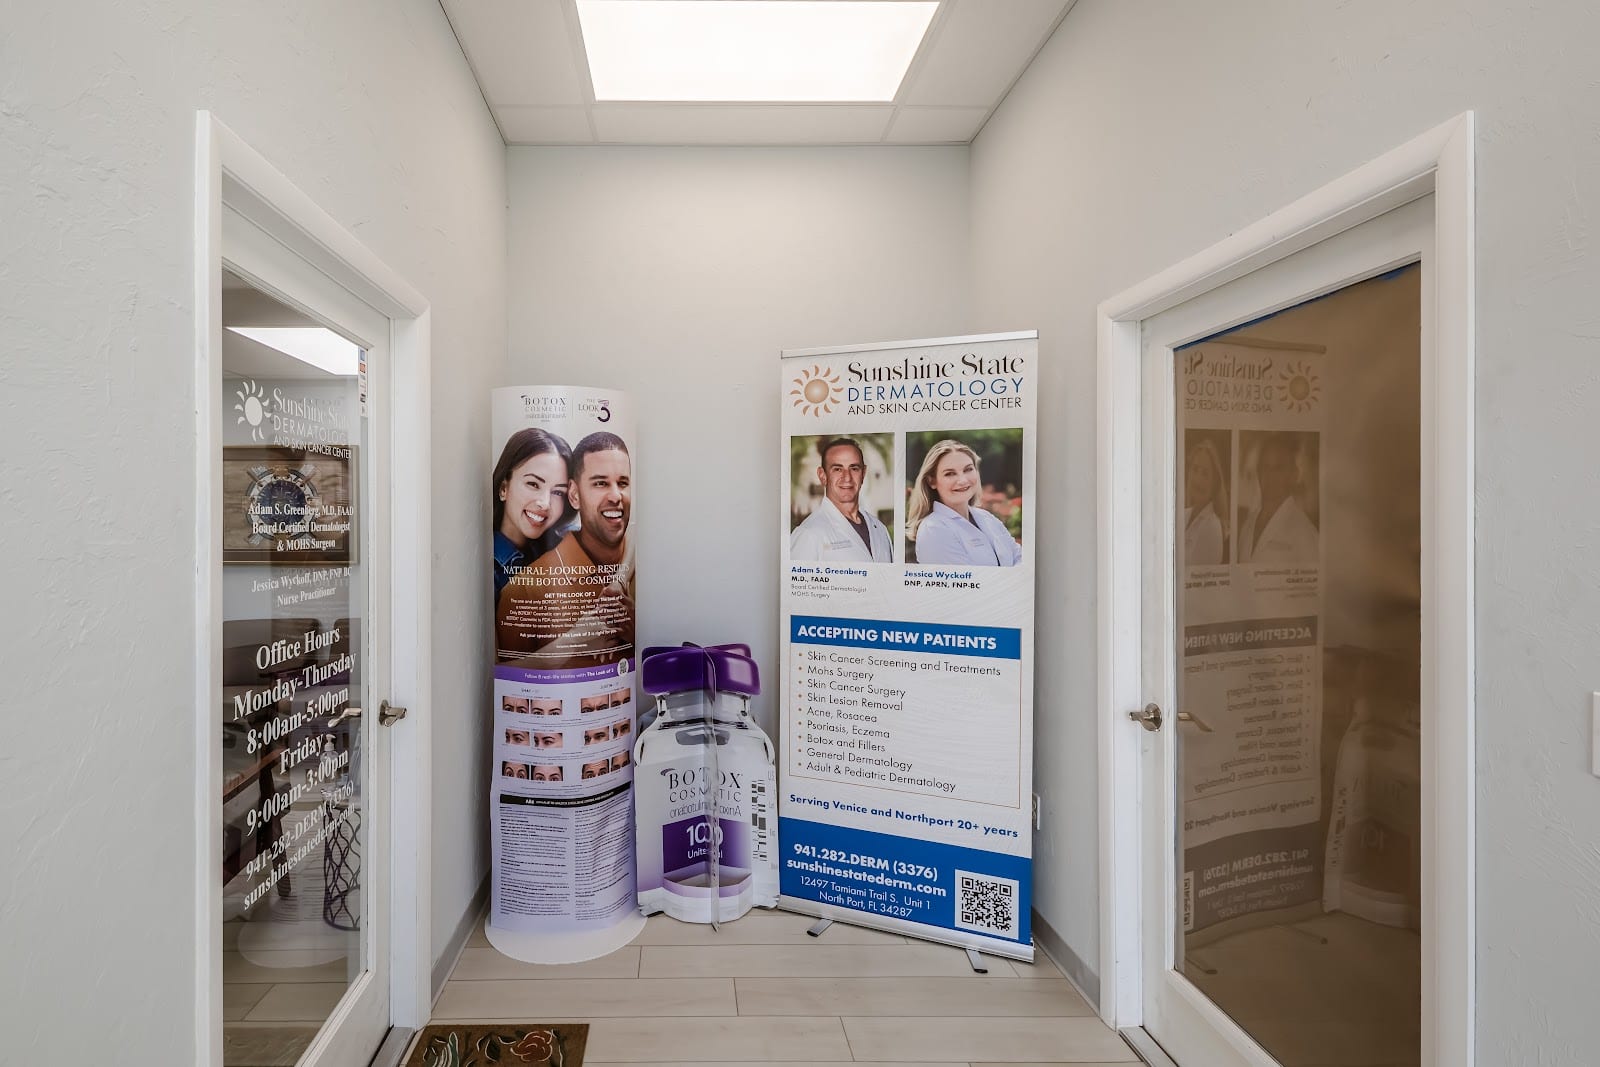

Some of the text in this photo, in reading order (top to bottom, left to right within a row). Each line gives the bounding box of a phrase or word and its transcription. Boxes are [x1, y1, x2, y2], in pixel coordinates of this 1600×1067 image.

[848, 353, 1024, 383] Sunshine State
[848, 377, 1024, 402] DERMATOLOGY
[274, 388, 325, 423] Sunshine
[578, 403, 600, 412] LOOK
[848, 397, 1022, 415] AND SKIN CANCER CENTER
[273, 415, 349, 445] DERMATOLOG
[273, 435, 351, 459] AND SKIN CANCER CENTER
[248, 503, 273, 515] Adam
[275, 504, 282, 514] S.
[283, 503, 321, 518] Greenberg,
[337, 506, 354, 516] FAAD
[252, 521, 351, 534] Board Certified Dermatologist
[277, 538, 336, 551] & MOHS Surgeon
[503, 565, 596, 576] NATURAL-LOOKING
[508, 576, 534, 586] WITH
[791, 566, 814, 574] Adam
[825, 567, 868, 577] Greenberg
[904, 570, 972, 580] Jessica Wyckoff
[251, 579, 279, 593] Jessica
[810, 591, 830, 599] Surgery
[828, 585, 867, 593] Dermatologist
[904, 580, 923, 588] DNP,
[925, 580, 950, 589] APRN,
[277, 587, 336, 607] Nurse Practitioner
[256, 628, 340, 670] Office Hours
[797, 625, 997, 650] ACCEPTING NEW PATIENTS
[807, 651, 1001, 676] Skin Cancer Screening and Treatments
[807, 665, 874, 682] Mohs Surgery
[233, 653, 356, 720] Monday-Thursday
[807, 678, 906, 700] Skin Cancer Surgery
[807, 692, 903, 711] Skin Lesion Removal
[247, 687, 348, 754] 8:00am-5:00pm
[806, 706, 878, 723] Acne, Rosacea
[807, 720, 890, 739] Psoriasis, Eczema
[280, 733, 323, 774] Friday
[807, 734, 886, 752] Botox and Fillers
[806, 748, 913, 772] General Dermatology
[806, 761, 956, 793] Adult & Pediatric Dermatology
[246, 750, 348, 837] 9:00am-3:00pm
[790, 794, 830, 810] Serving
[832, 800, 868, 815] Venice
[870, 806, 892, 818] and
[895, 810, 954, 828] Northport
[957, 820, 980, 831] 20+
[983, 825, 1019, 839] years
[246, 802, 329, 882] 941-282-DERM
[244, 803, 355, 910] sunshinestatederm.com
[793, 843, 938, 881] 941.282.DERM (3376)
[787, 857, 947, 897] sunshinestatederm.com
[800, 875, 931, 910] 12497 Tamiami Trail S. Unit 1
[819, 890, 913, 919] North Port, FL 34287
